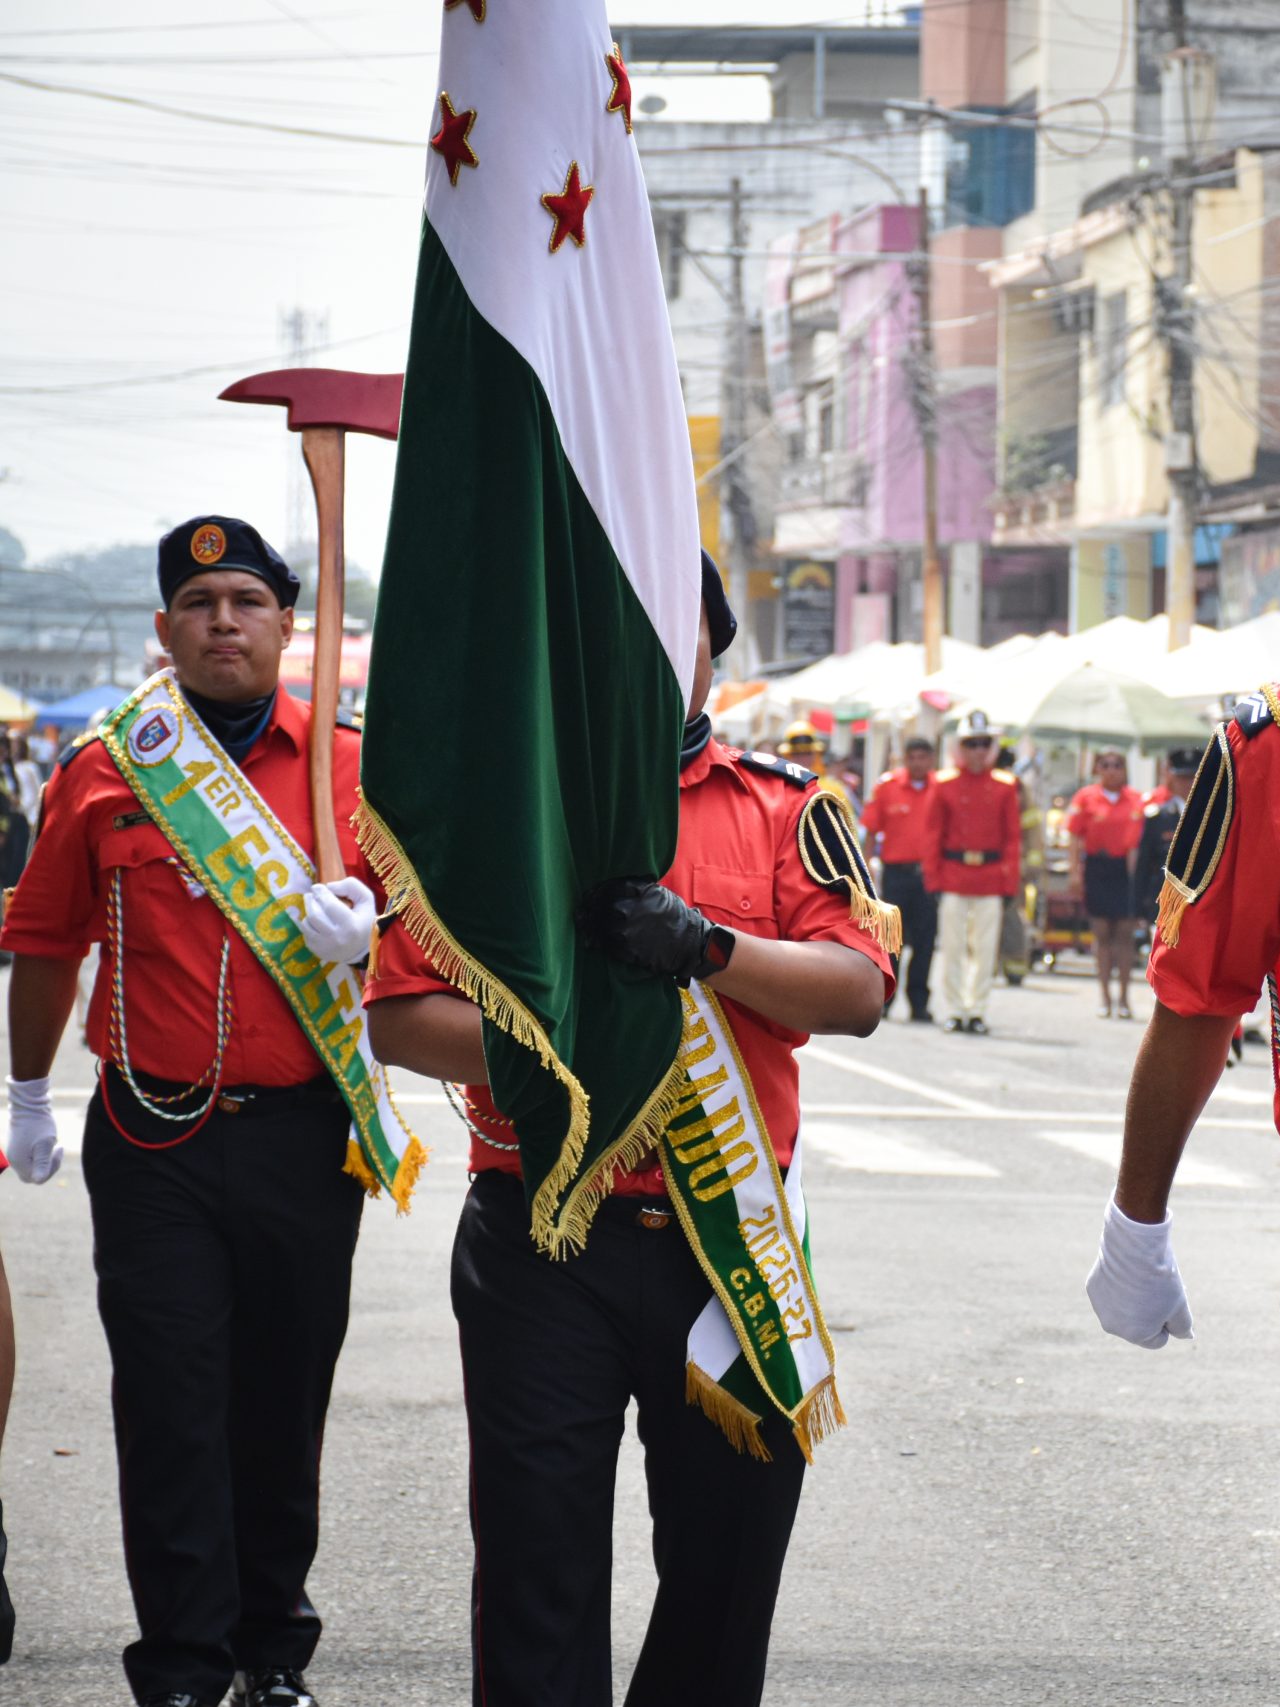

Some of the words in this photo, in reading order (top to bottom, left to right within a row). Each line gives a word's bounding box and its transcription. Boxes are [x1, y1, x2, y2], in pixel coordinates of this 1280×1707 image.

[161, 760, 242, 818] 1ER
[729, 1266, 780, 1361] C.B.M.
[737, 1203, 813, 1345] 2026-27
